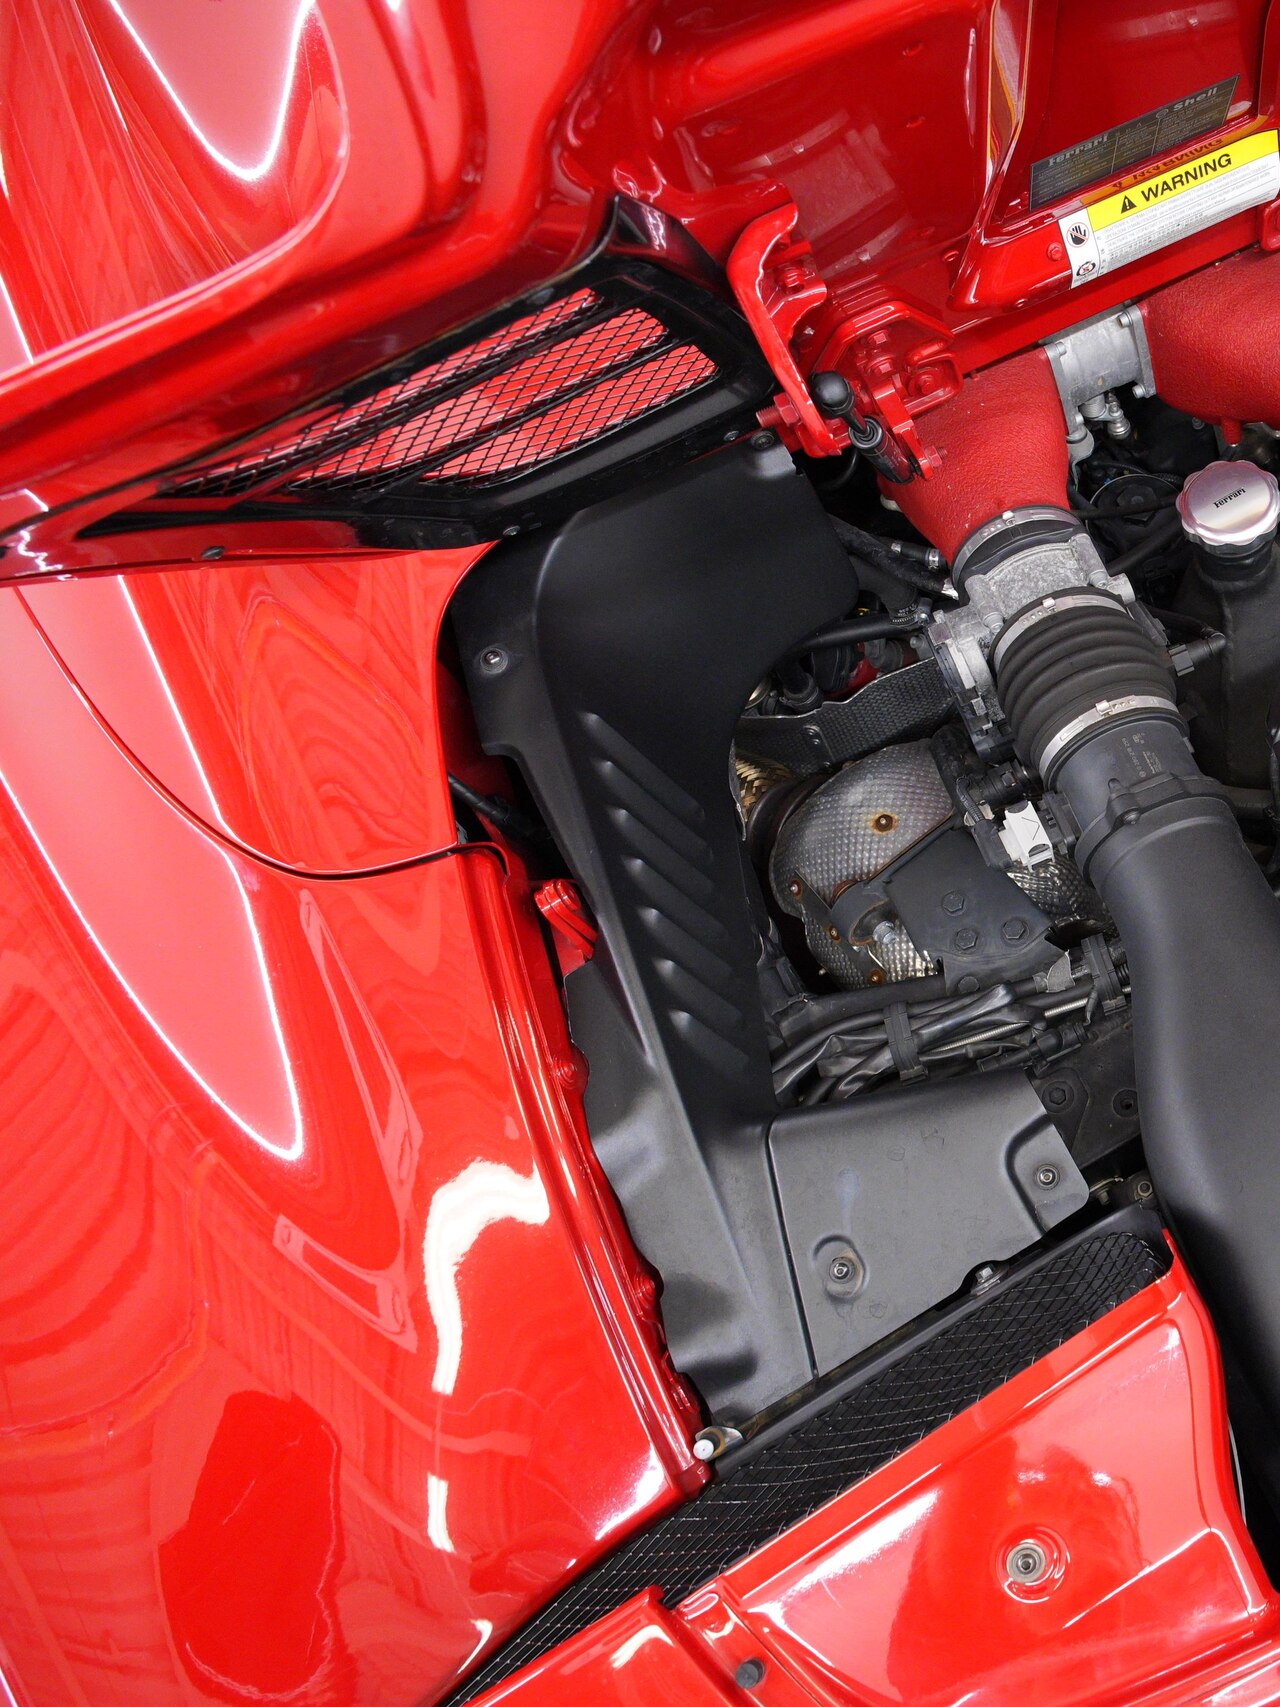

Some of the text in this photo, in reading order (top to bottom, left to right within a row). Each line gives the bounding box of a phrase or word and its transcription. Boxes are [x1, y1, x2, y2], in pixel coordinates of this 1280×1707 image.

[1173, 87, 1218, 110] Shell
[1048, 134, 1108, 167] Ferrari
[1141, 153, 1232, 202] WARNING
[1213, 487, 1246, 508] Ferrari
